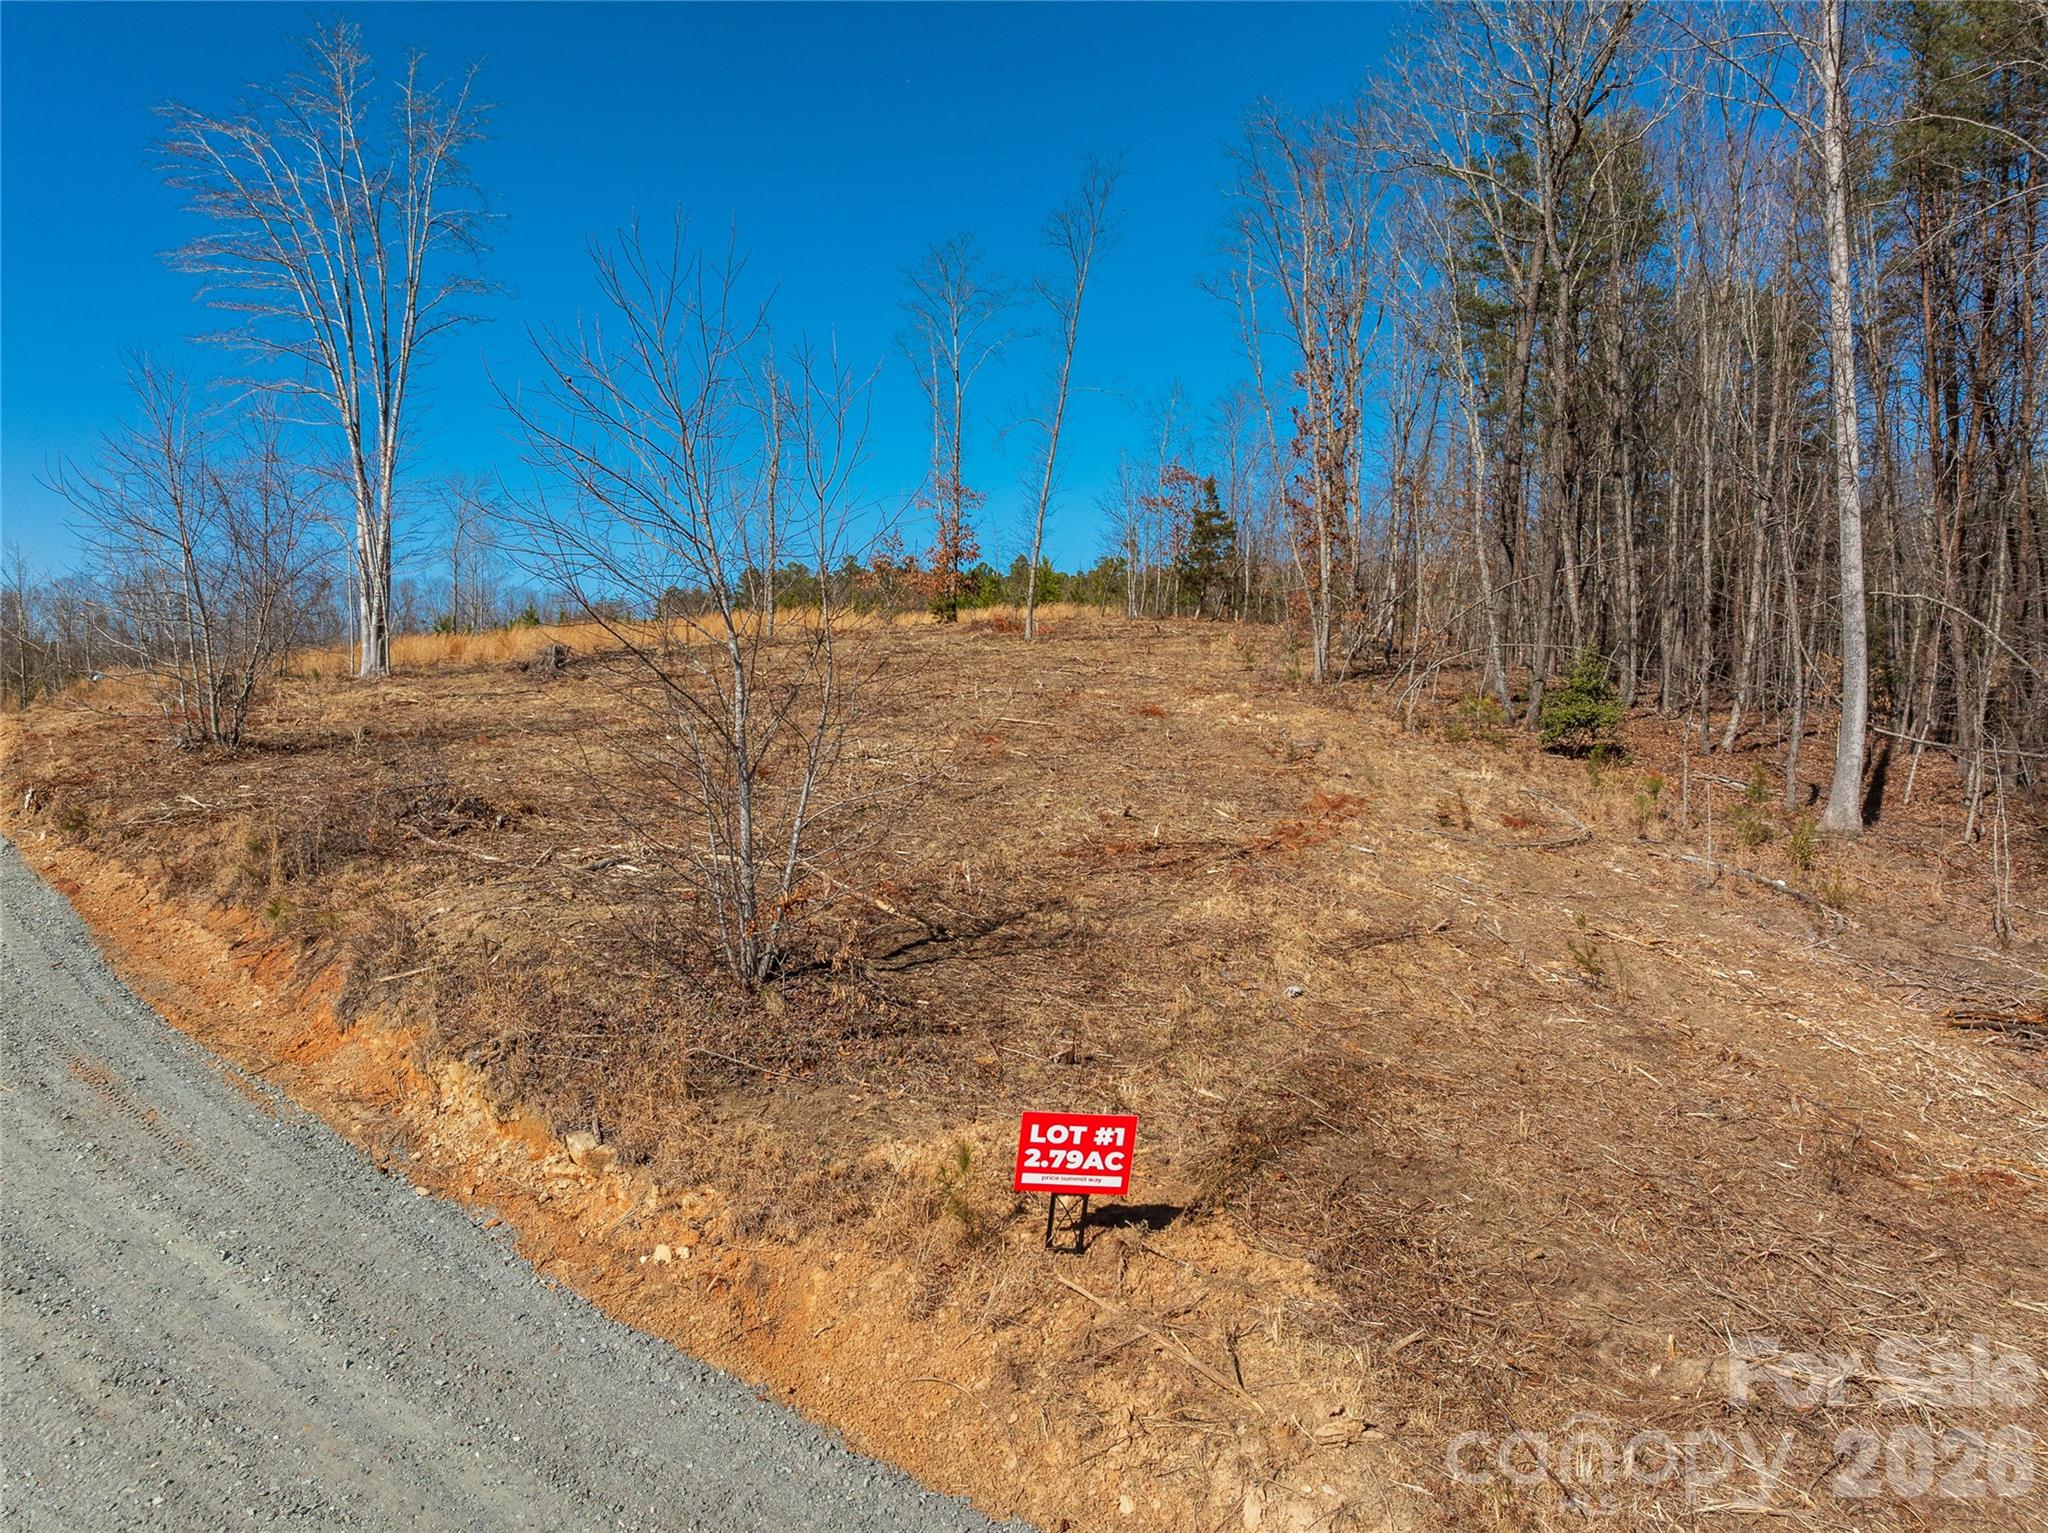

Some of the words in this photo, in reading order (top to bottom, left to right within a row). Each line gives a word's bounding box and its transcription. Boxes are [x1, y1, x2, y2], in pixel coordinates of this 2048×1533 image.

[1029, 1124, 1088, 1145] LOT
[1093, 1126, 1126, 1146] #1
[1023, 1148, 1125, 1171] 2.79AC
